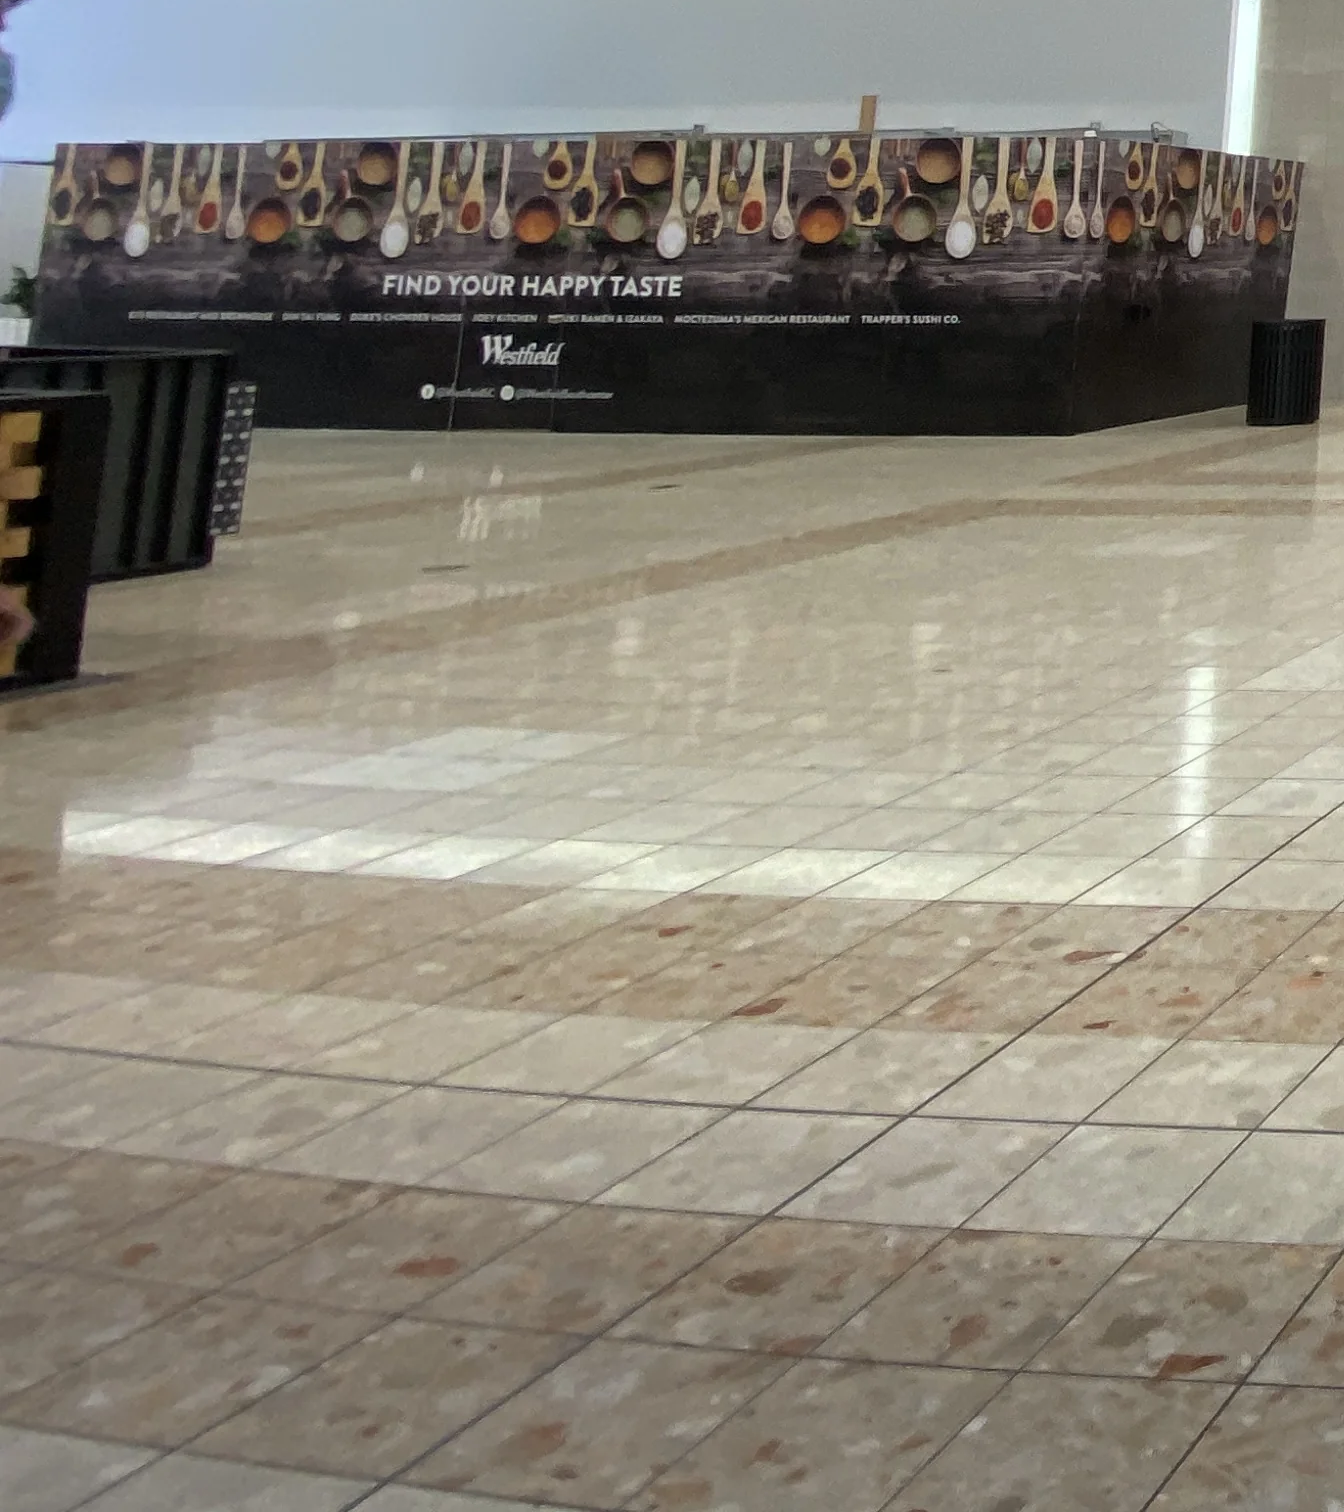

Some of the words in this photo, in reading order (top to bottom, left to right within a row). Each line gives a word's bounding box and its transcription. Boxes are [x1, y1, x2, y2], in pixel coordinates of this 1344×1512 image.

[381, 275, 441, 296] FIND
[449, 275, 516, 296] YOUR
[521, 275, 606, 297] HAPPY
[610, 275, 684, 297] TASTE
[742, 314, 788, 325] MEXICAN
[788, 315, 851, 325] RESTAURANT
[861, 315, 911, 325] TRAPPER'S
[912, 315, 942, 325] SUSHI
[943, 315, 960, 325] CO.
[481, 334, 566, 365] Westfield
